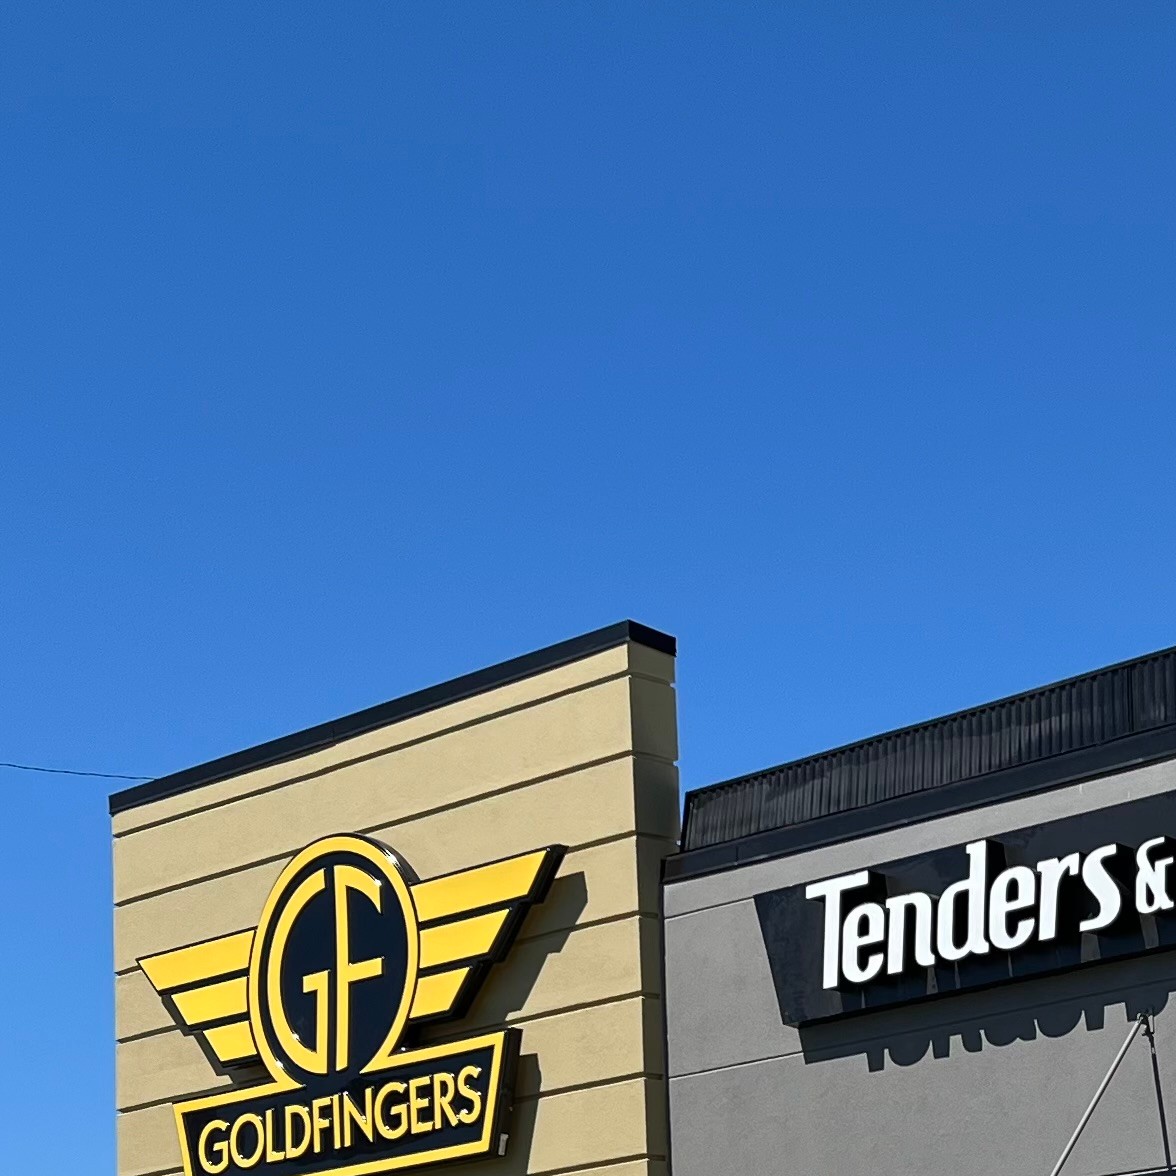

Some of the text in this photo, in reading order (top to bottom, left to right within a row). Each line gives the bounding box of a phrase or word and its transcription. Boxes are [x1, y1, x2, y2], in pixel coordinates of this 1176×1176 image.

[267, 865, 384, 1074] GF
[806, 839, 1122, 989] Tenders
[1135, 836, 1175, 914] &
[197, 1066, 481, 1175] GOLDFINGERS
